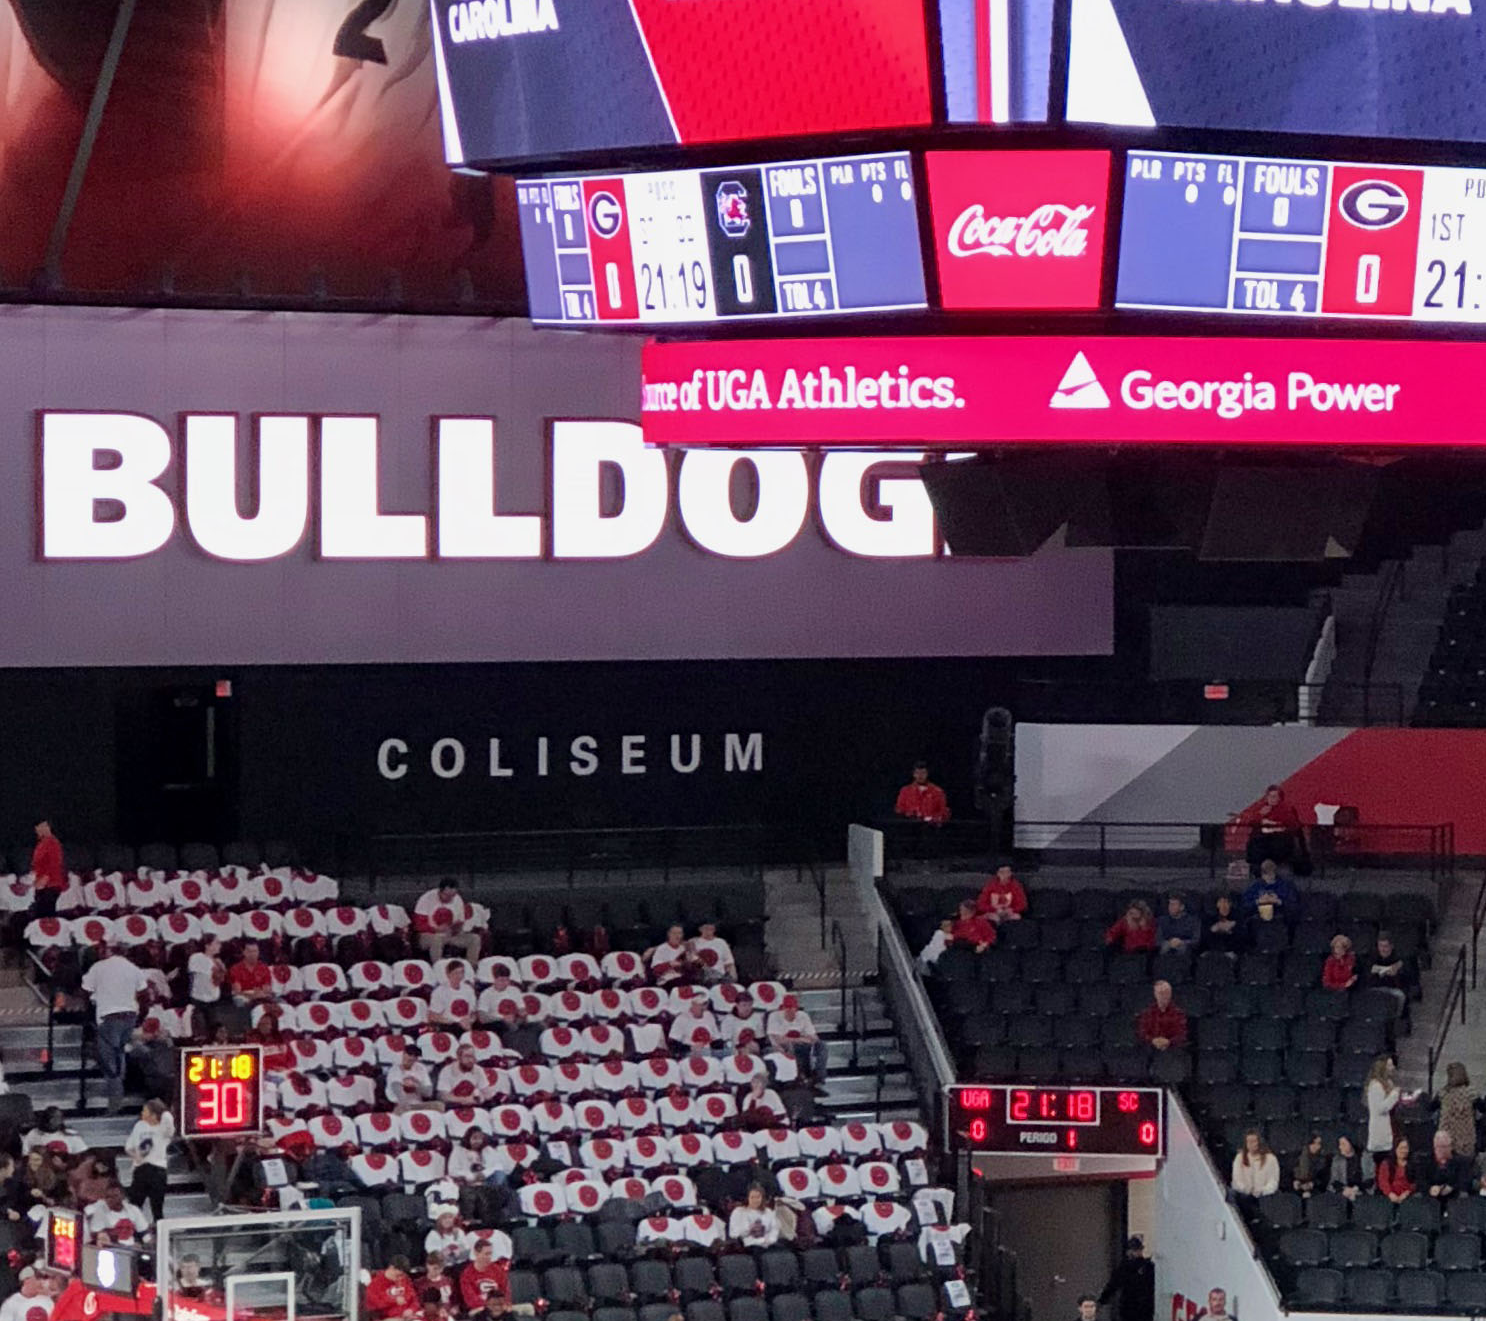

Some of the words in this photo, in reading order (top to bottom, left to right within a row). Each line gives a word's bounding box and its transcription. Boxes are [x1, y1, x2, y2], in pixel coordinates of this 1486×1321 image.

[770, 167, 817, 197] FOULS
[862, 162, 886, 181] PTS
[1131, 159, 1161, 178] PLR
[1174, 161, 1206, 181] PTS
[1217, 164, 1233, 183] FL
[1254, 165, 1319, 195] FOULS
[872, 184, 883, 203] 0
[901, 182, 912, 201] 0
[1185, 184, 1198, 203] 0
[1223, 186, 1236, 205] 0
[791, 199, 804, 228] 0
[1272, 197, 1290, 227] 0
[947, 204, 1096, 258] Coca-Cola
[1431, 214, 1465, 243] 1ST
[605, 262, 622, 309] 0
[641, 260, 706, 310] 21:19
[732, 254, 755, 304] 0
[1356, 254, 1381, 304] 0
[1244, 281, 1280, 310] TOL
[1290, 283, 1306, 312] 4
[680, 369, 704, 411] of
[706, 369, 772, 410] UGA
[777, 365, 966, 410] Athletics.
[1121, 371, 1276, 419] Georgia
[1288, 373, 1400, 412] Power
[36, 409, 976, 562] BULLDOG
[377, 733, 764, 780] COLISEUM
[189, 1054, 252, 1082] 21:18
[199, 1082, 244, 1126] 30
[961, 1089, 991, 1109] UGA
[1012, 1091, 1094, 1120] 21:18
[1117, 1092, 1139, 1111] SC
[971, 1120, 986, 1141] 0
[1020, 1132, 1058, 1144] PERIOD
[1067, 1130, 1077, 1148] 1
[1139, 1122, 1155, 1145] 0
